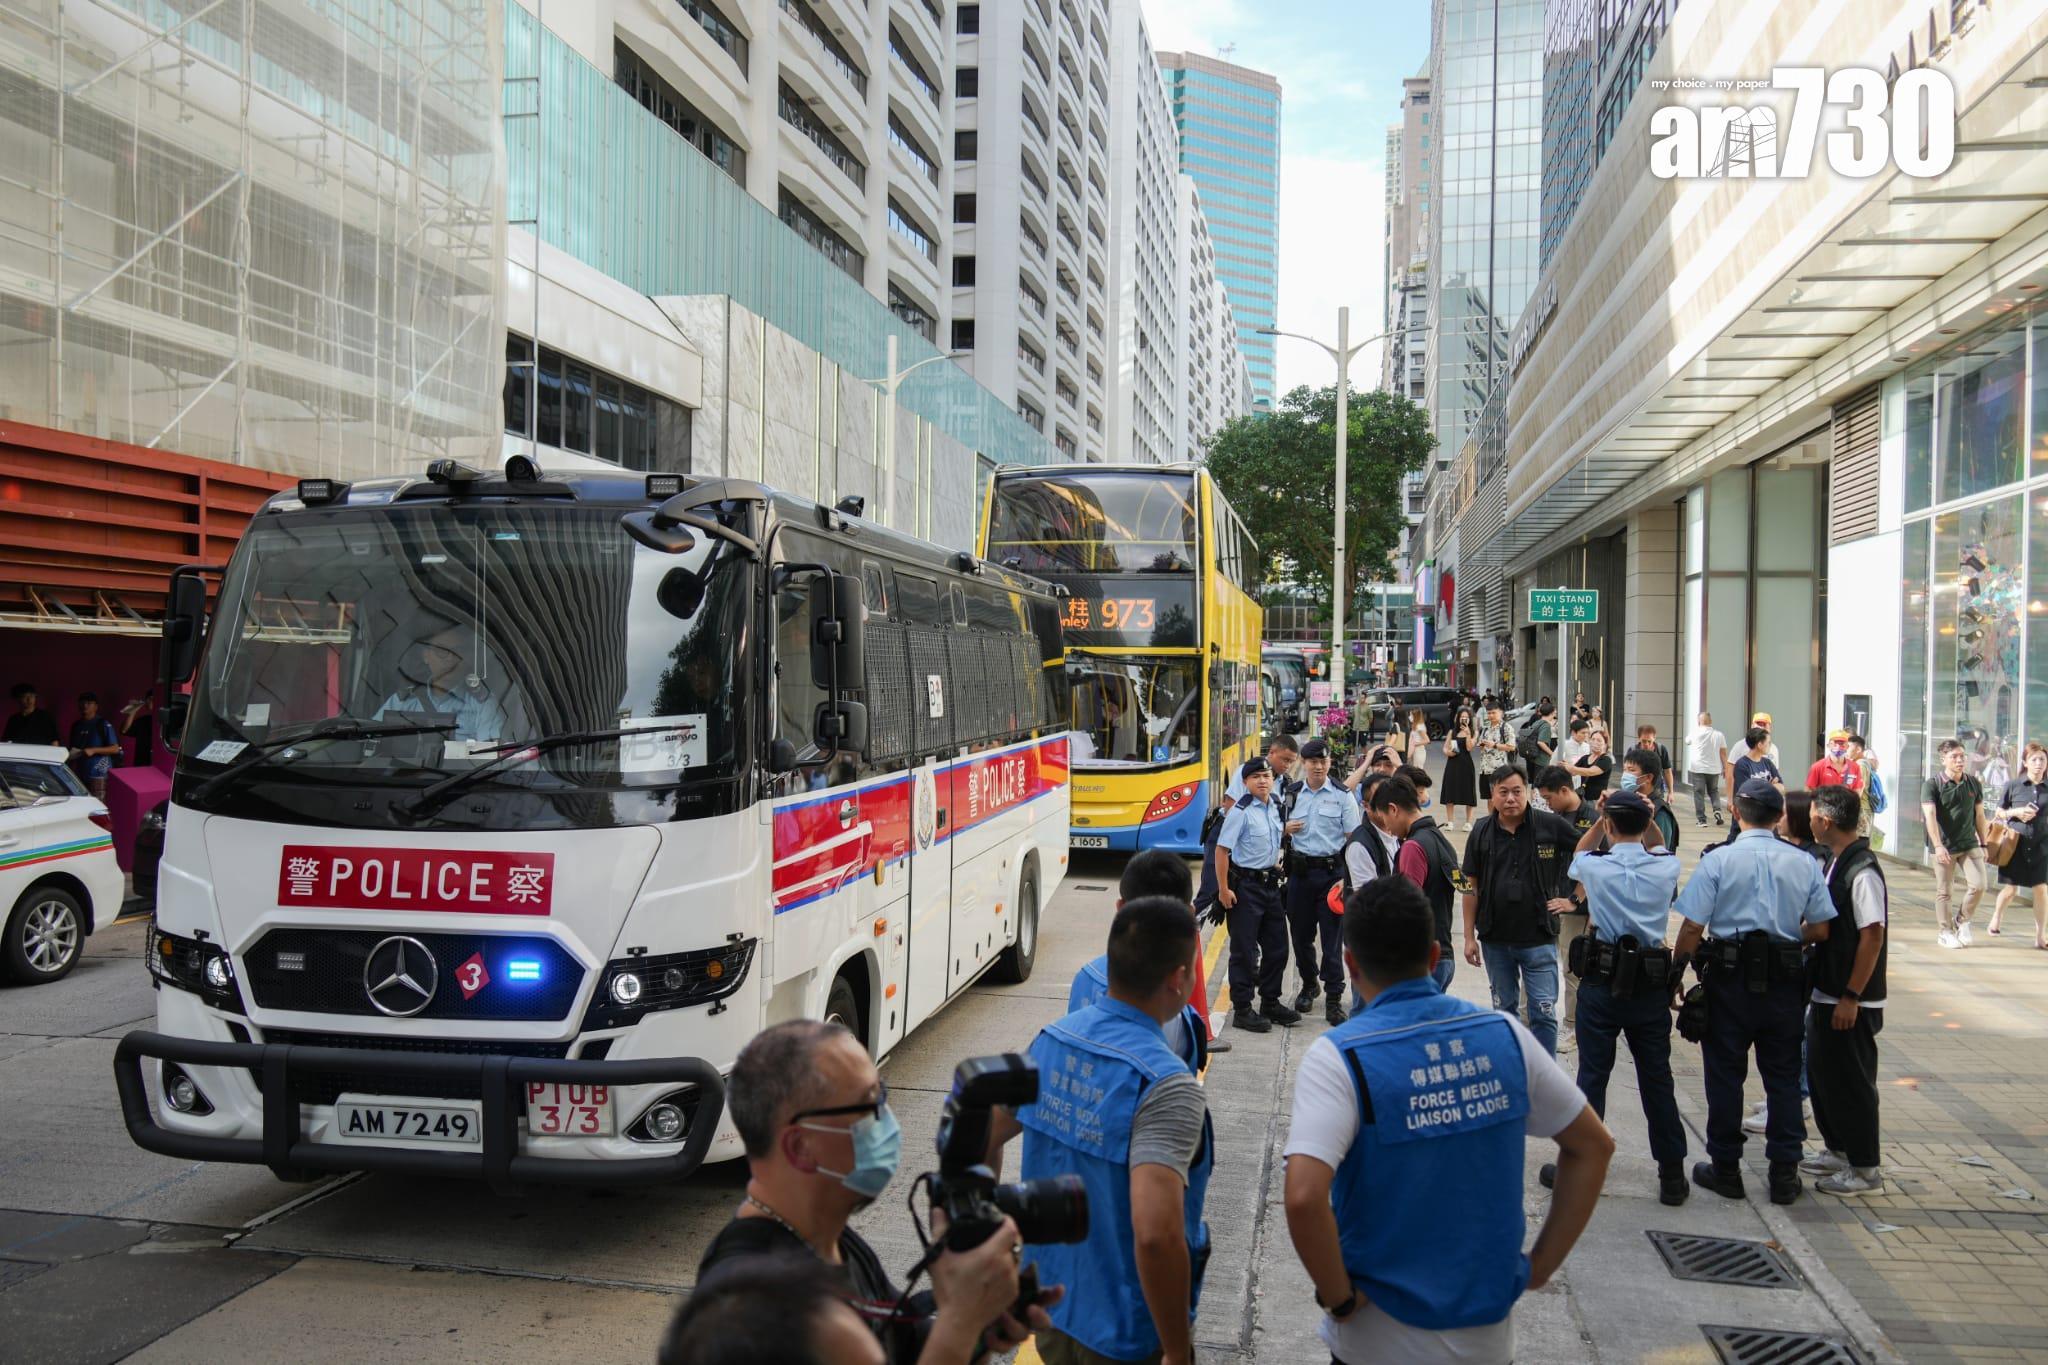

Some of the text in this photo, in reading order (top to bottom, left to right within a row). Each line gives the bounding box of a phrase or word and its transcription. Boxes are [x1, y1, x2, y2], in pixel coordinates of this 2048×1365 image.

[1069, 598, 1089, 617] 柱
[1101, 598, 1154, 629] 973
[1535, 595, 1593, 603] TAXI STAND
[1541, 606, 1585, 617] 的士站
[666, 753, 691, 768] 3/3
[983, 760, 1015, 812] POLICE
[1017, 756, 1026, 797] 察
[968, 770, 980, 818] 警
[1080, 837, 1103, 847] 1605
[287, 856, 320, 896] 警
[329, 857, 494, 902] POLICE
[507, 864, 545, 904] 察
[462, 962, 482, 991] 3
[1410, 1079, 1503, 1111] FORCE MEDIA
[349, 1109, 469, 1138] AM 7249
[540, 1106, 600, 1134] 3/3
[1406, 1094, 1511, 1130] LIAISON CADRE
